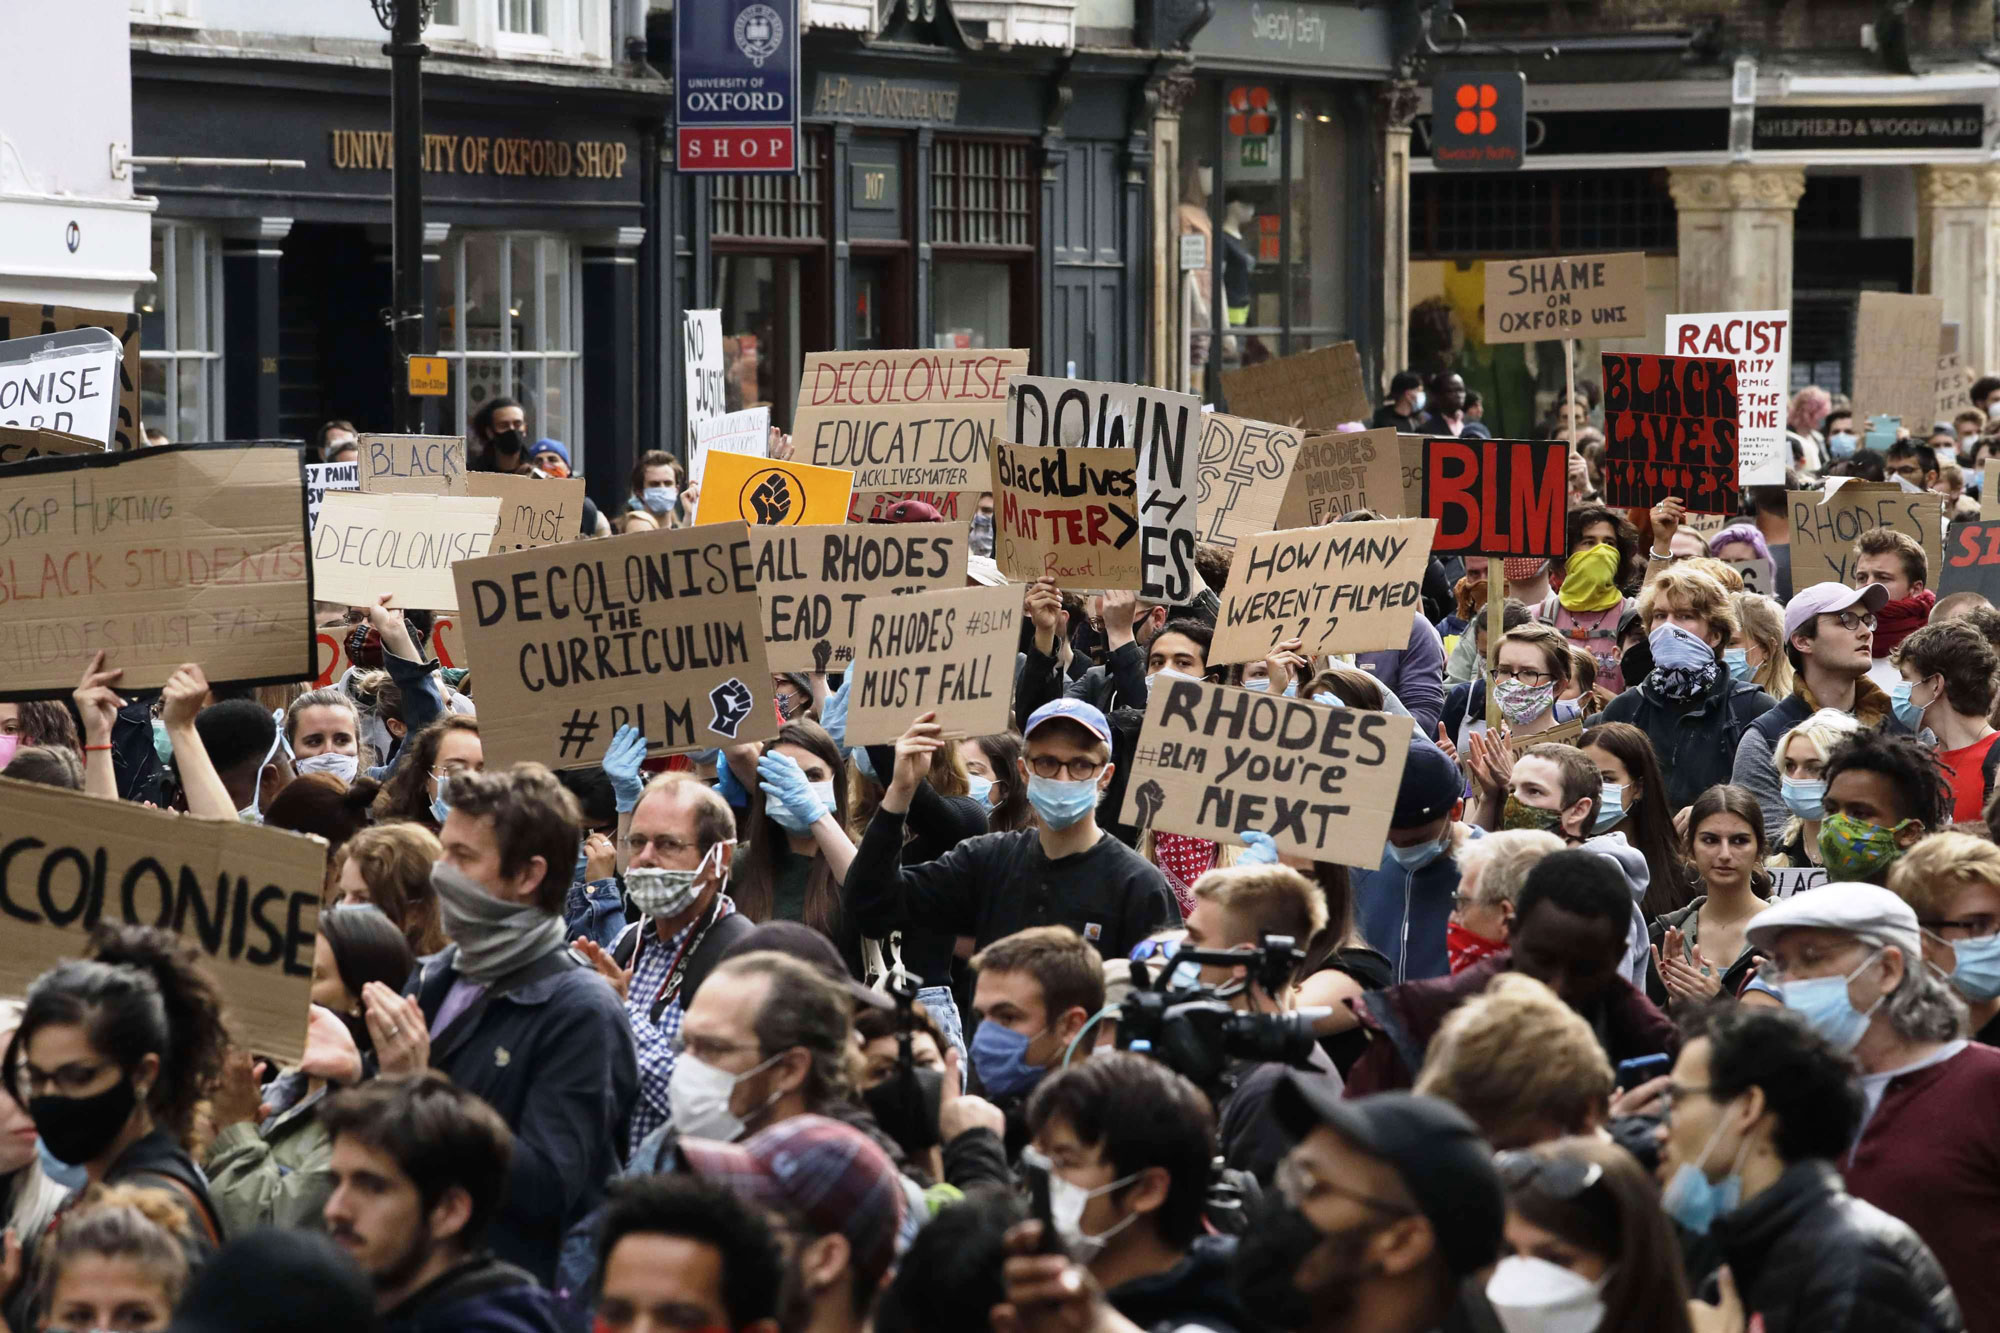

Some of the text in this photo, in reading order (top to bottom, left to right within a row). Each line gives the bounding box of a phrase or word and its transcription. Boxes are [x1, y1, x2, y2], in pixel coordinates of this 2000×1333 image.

[687, 91, 784, 112] OXFORD
[688, 77, 764, 89] UNIVERSITY OF
[688, 138, 784, 159] SHOP
[1757, 118, 1853, 137] SHEPHERD
[1869, 117, 1979, 136] WOODWARD
[333, 130, 627, 178] UNIVITY OF OXFORD SHOP
[865, 172, 885, 200] 107
[1508, 262, 1605, 297] SHAME
[1546, 294, 1572, 309] ON
[687, 319, 704, 362] NO
[1500, 305, 1627, 334] OXFORD UNI
[1677, 320, 1788, 355] RACIST
[812, 355, 1012, 406] DECOLONISE
[1602, 355, 1737, 419] BLACK
[1748, 393, 1780, 406] THE
[812, 417, 996, 467] EDUCATION
[1014, 383, 1189, 489] DOWN
[1605, 412, 1736, 466] LIVES
[370, 442, 459, 478] BLACK
[853, 467, 968, 488] LACKLIVESMATTER
[1305, 466, 1367, 497] MUST
[72, 477, 174, 536] HURTING
[1429, 442, 1567, 555] BLM
[1606, 461, 1739, 514] MATTER
[1003, 490, 1112, 546] MATTER
[1794, 500, 1924, 545] RHODES
[124, 544, 306, 588] STUDENTS
[315, 524, 491, 569] DECOLONISE
[821, 534, 953, 583] RHODES
[1246, 535, 1409, 585] HOW MANY
[472, 540, 758, 627] DECOLONISE
[1227, 580, 1421, 627] WEREN'T FILMED
[584, 608, 643, 634] THE
[868, 607, 1013, 660] RHODES #BLM
[519, 620, 750, 692] CURRICULUM
[860, 654, 993, 709] MUST FALL
[1159, 680, 1388, 767] RHODES
[1136, 742, 1206, 774] #BLM
[1197, 785, 1351, 849] NEXT
